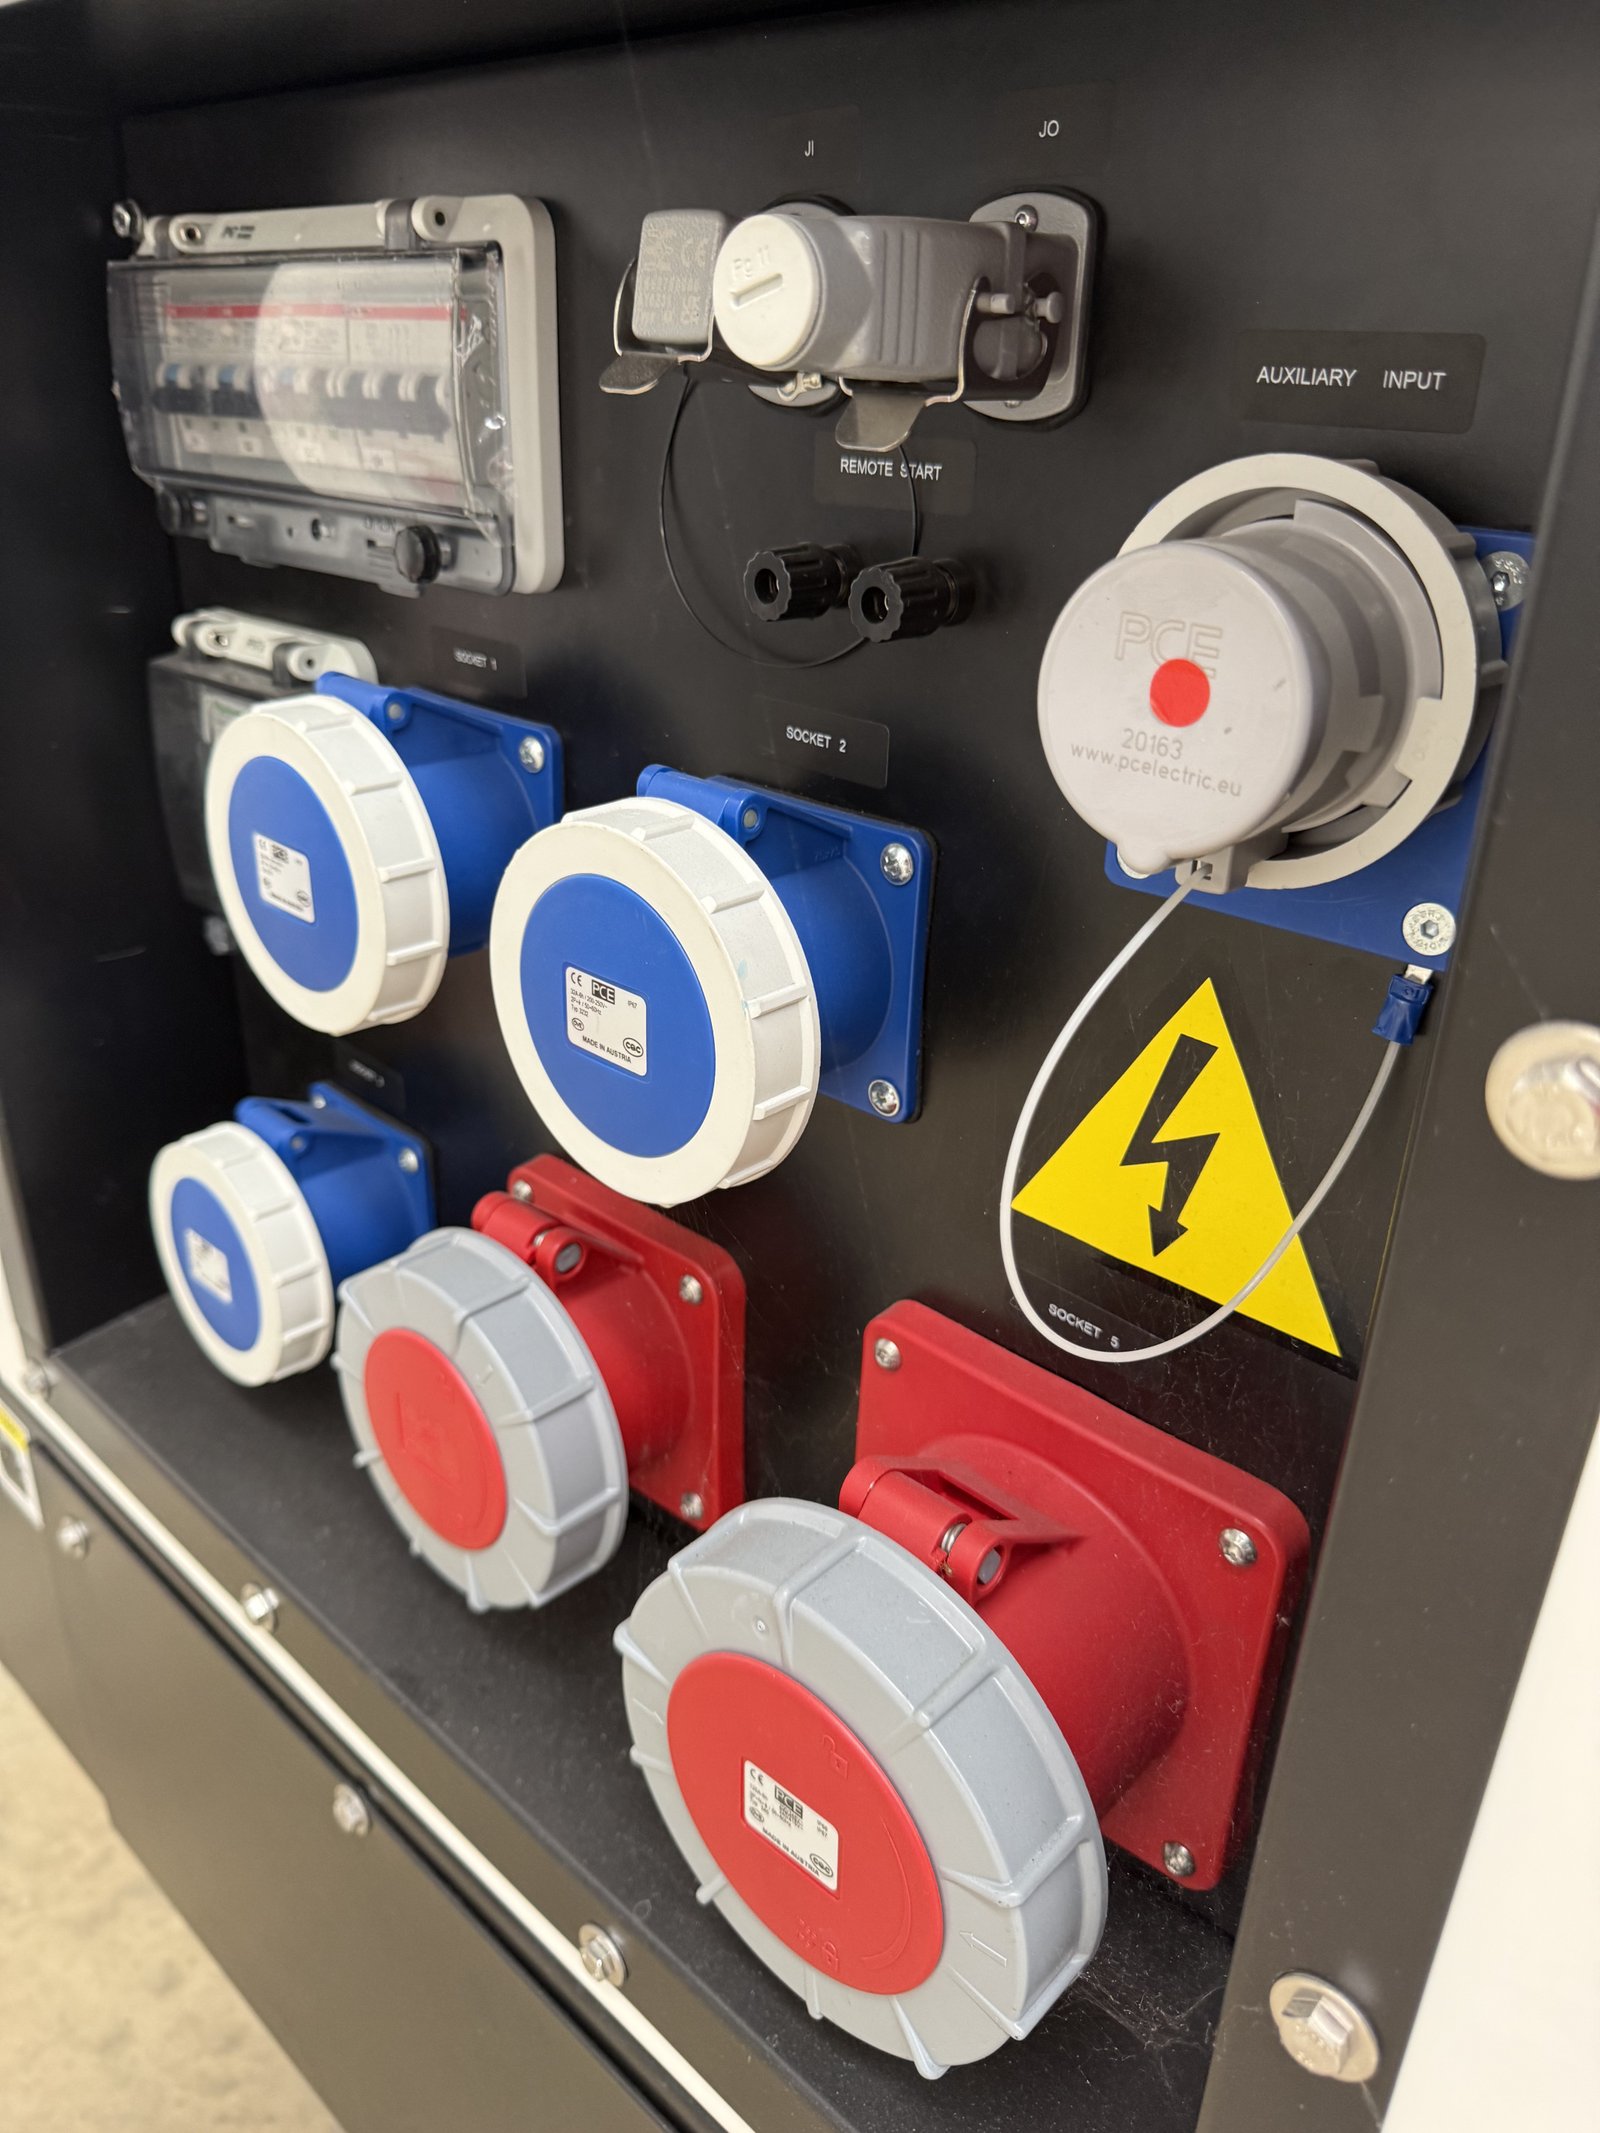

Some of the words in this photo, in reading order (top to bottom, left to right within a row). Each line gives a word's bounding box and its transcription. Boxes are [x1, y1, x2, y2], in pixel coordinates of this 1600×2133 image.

[1256, 366, 1358, 387] AUXILIARY
[1383, 370, 1447, 391] INPUT
[840, 458, 893, 477] REMOTE
[900, 463, 942, 481] START
[1114, 610, 1223, 680] PCE
[785, 725, 831, 749] SOCKET
[839, 738, 847, 753] 2
[1121, 727, 1184, 761] 20163
[1070, 743, 1243, 797] www.pcelectric.eu
[592, 979, 615, 1005] PCE
[582, 1035, 599, 1049] MADE
[599, 1043, 606, 1052] IN
[606, 1046, 632, 1064] AUSTRIA
[1048, 1303, 1103, 1339] SOCKET
[1110, 1335, 1120, 1349] 5
[774, 1785, 803, 1819] PCE
